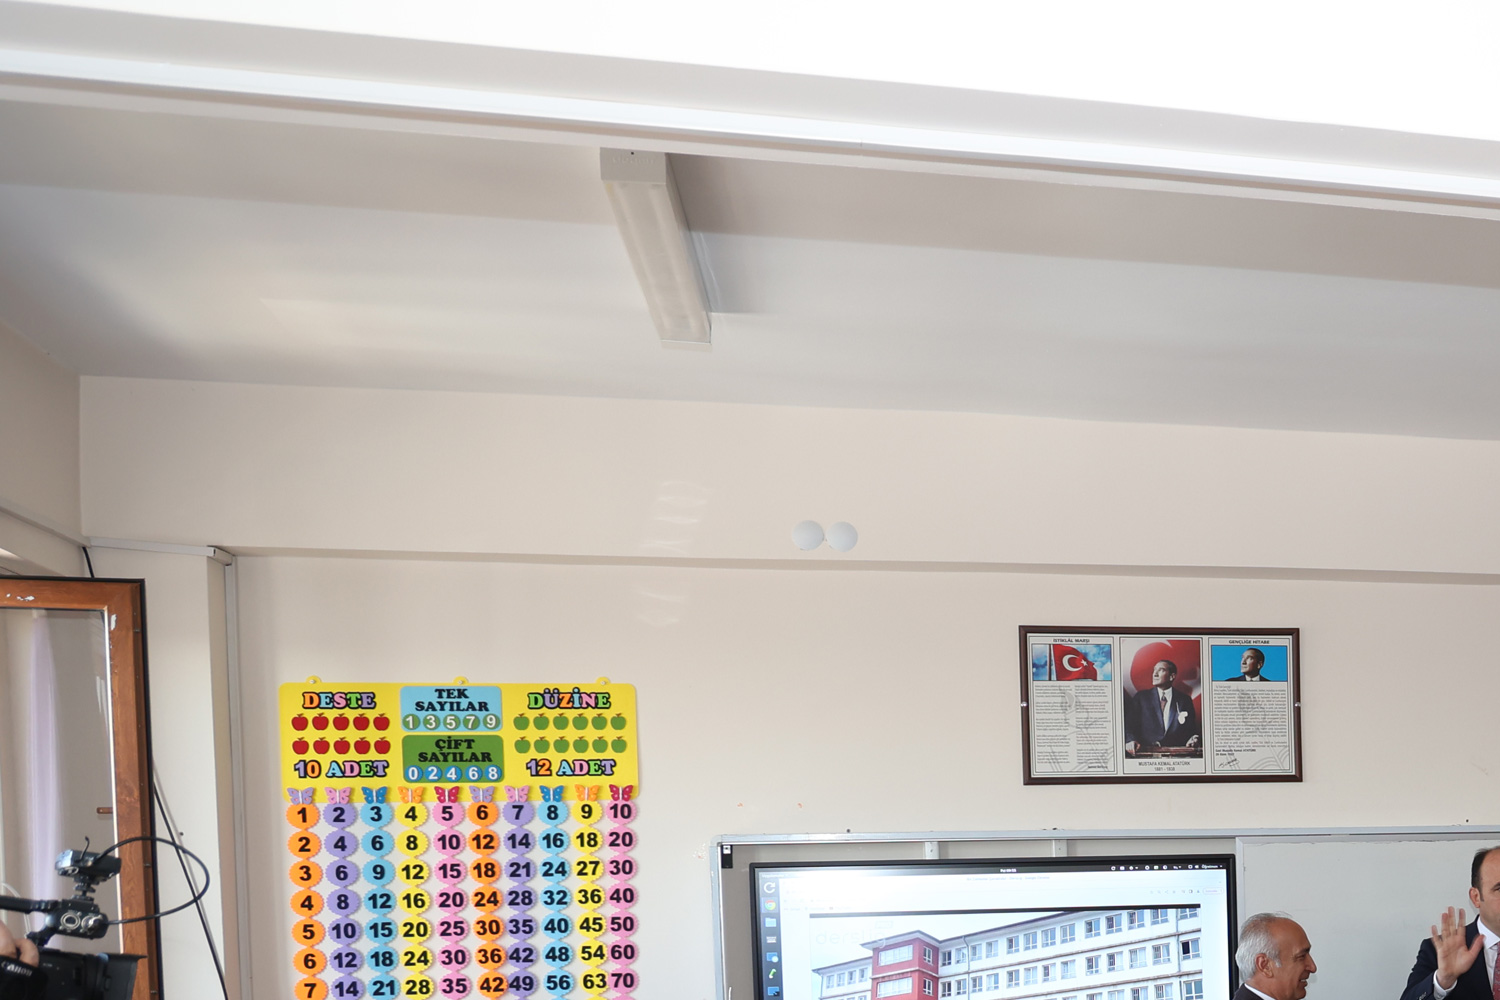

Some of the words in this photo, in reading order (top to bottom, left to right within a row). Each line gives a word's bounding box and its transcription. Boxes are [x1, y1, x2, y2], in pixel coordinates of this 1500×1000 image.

[302, 692, 376, 709] DESTE
[435, 688, 470, 699] TEK
[528, 687, 611, 709] DÜZİNE
[415, 701, 489, 712] SAYILAR
[405, 716, 414, 729] 1
[426, 716, 436, 729] 3
[446, 716, 456, 729] 5
[466, 716, 476, 729] 7
[486, 715, 496, 728] 9
[435, 736, 475, 751] ÇİFT
[418, 752, 493, 763] SAYILAR
[294, 760, 321, 778] 10
[326, 760, 389, 778] ADET
[408, 767, 419, 780] 0
[428, 767, 438, 780] 2
[447, 767, 457, 780] 4
[468, 767, 478, 780] 6
[488, 767, 498, 780] 8
[526, 758, 551, 777] 12
[556, 759, 616, 777] ADET
[298, 808, 306, 823] 1
[333, 807, 345, 822] 2
[370, 806, 382, 821] 3
[405, 806, 417, 821] 4
[442, 806, 453, 821] 5
[477, 805, 488, 820] 6
[512, 805, 524, 820] 7
[547, 805, 558, 820] 8
[581, 804, 592, 819] 9
[610, 804, 631, 819] 10
[299, 837, 310, 852] 2
[334, 836, 347, 851] 4
[372, 835, 383, 851] 6
[406, 835, 418, 850] 8
[438, 835, 460, 849] 10
[472, 834, 494, 849] 12
[508, 834, 530, 848] 14
[543, 833, 564, 848] 16
[576, 833, 597, 847] 18
[609, 832, 633, 847] 20
[300, 866, 311, 881] 3
[336, 865, 348, 880] 6
[373, 865, 385, 880] 9
[402, 865, 424, 879] 12
[439, 864, 461, 878] 15
[473, 863, 495, 878] 18
[510, 862, 530, 877] 21
[543, 862, 567, 876] 24
[577, 861, 599, 876] 27
[610, 860, 633, 875] 30
[301, 896, 313, 910] 4
[337, 894, 349, 909] 8
[368, 893, 391, 909] 12
[403, 893, 425, 908] 16
[439, 892, 463, 907] 20
[475, 891, 499, 907] 24
[508, 891, 532, 905] 28
[544, 890, 567, 905] 32
[579, 889, 601, 904] 36
[610, 888, 634, 903] 40
